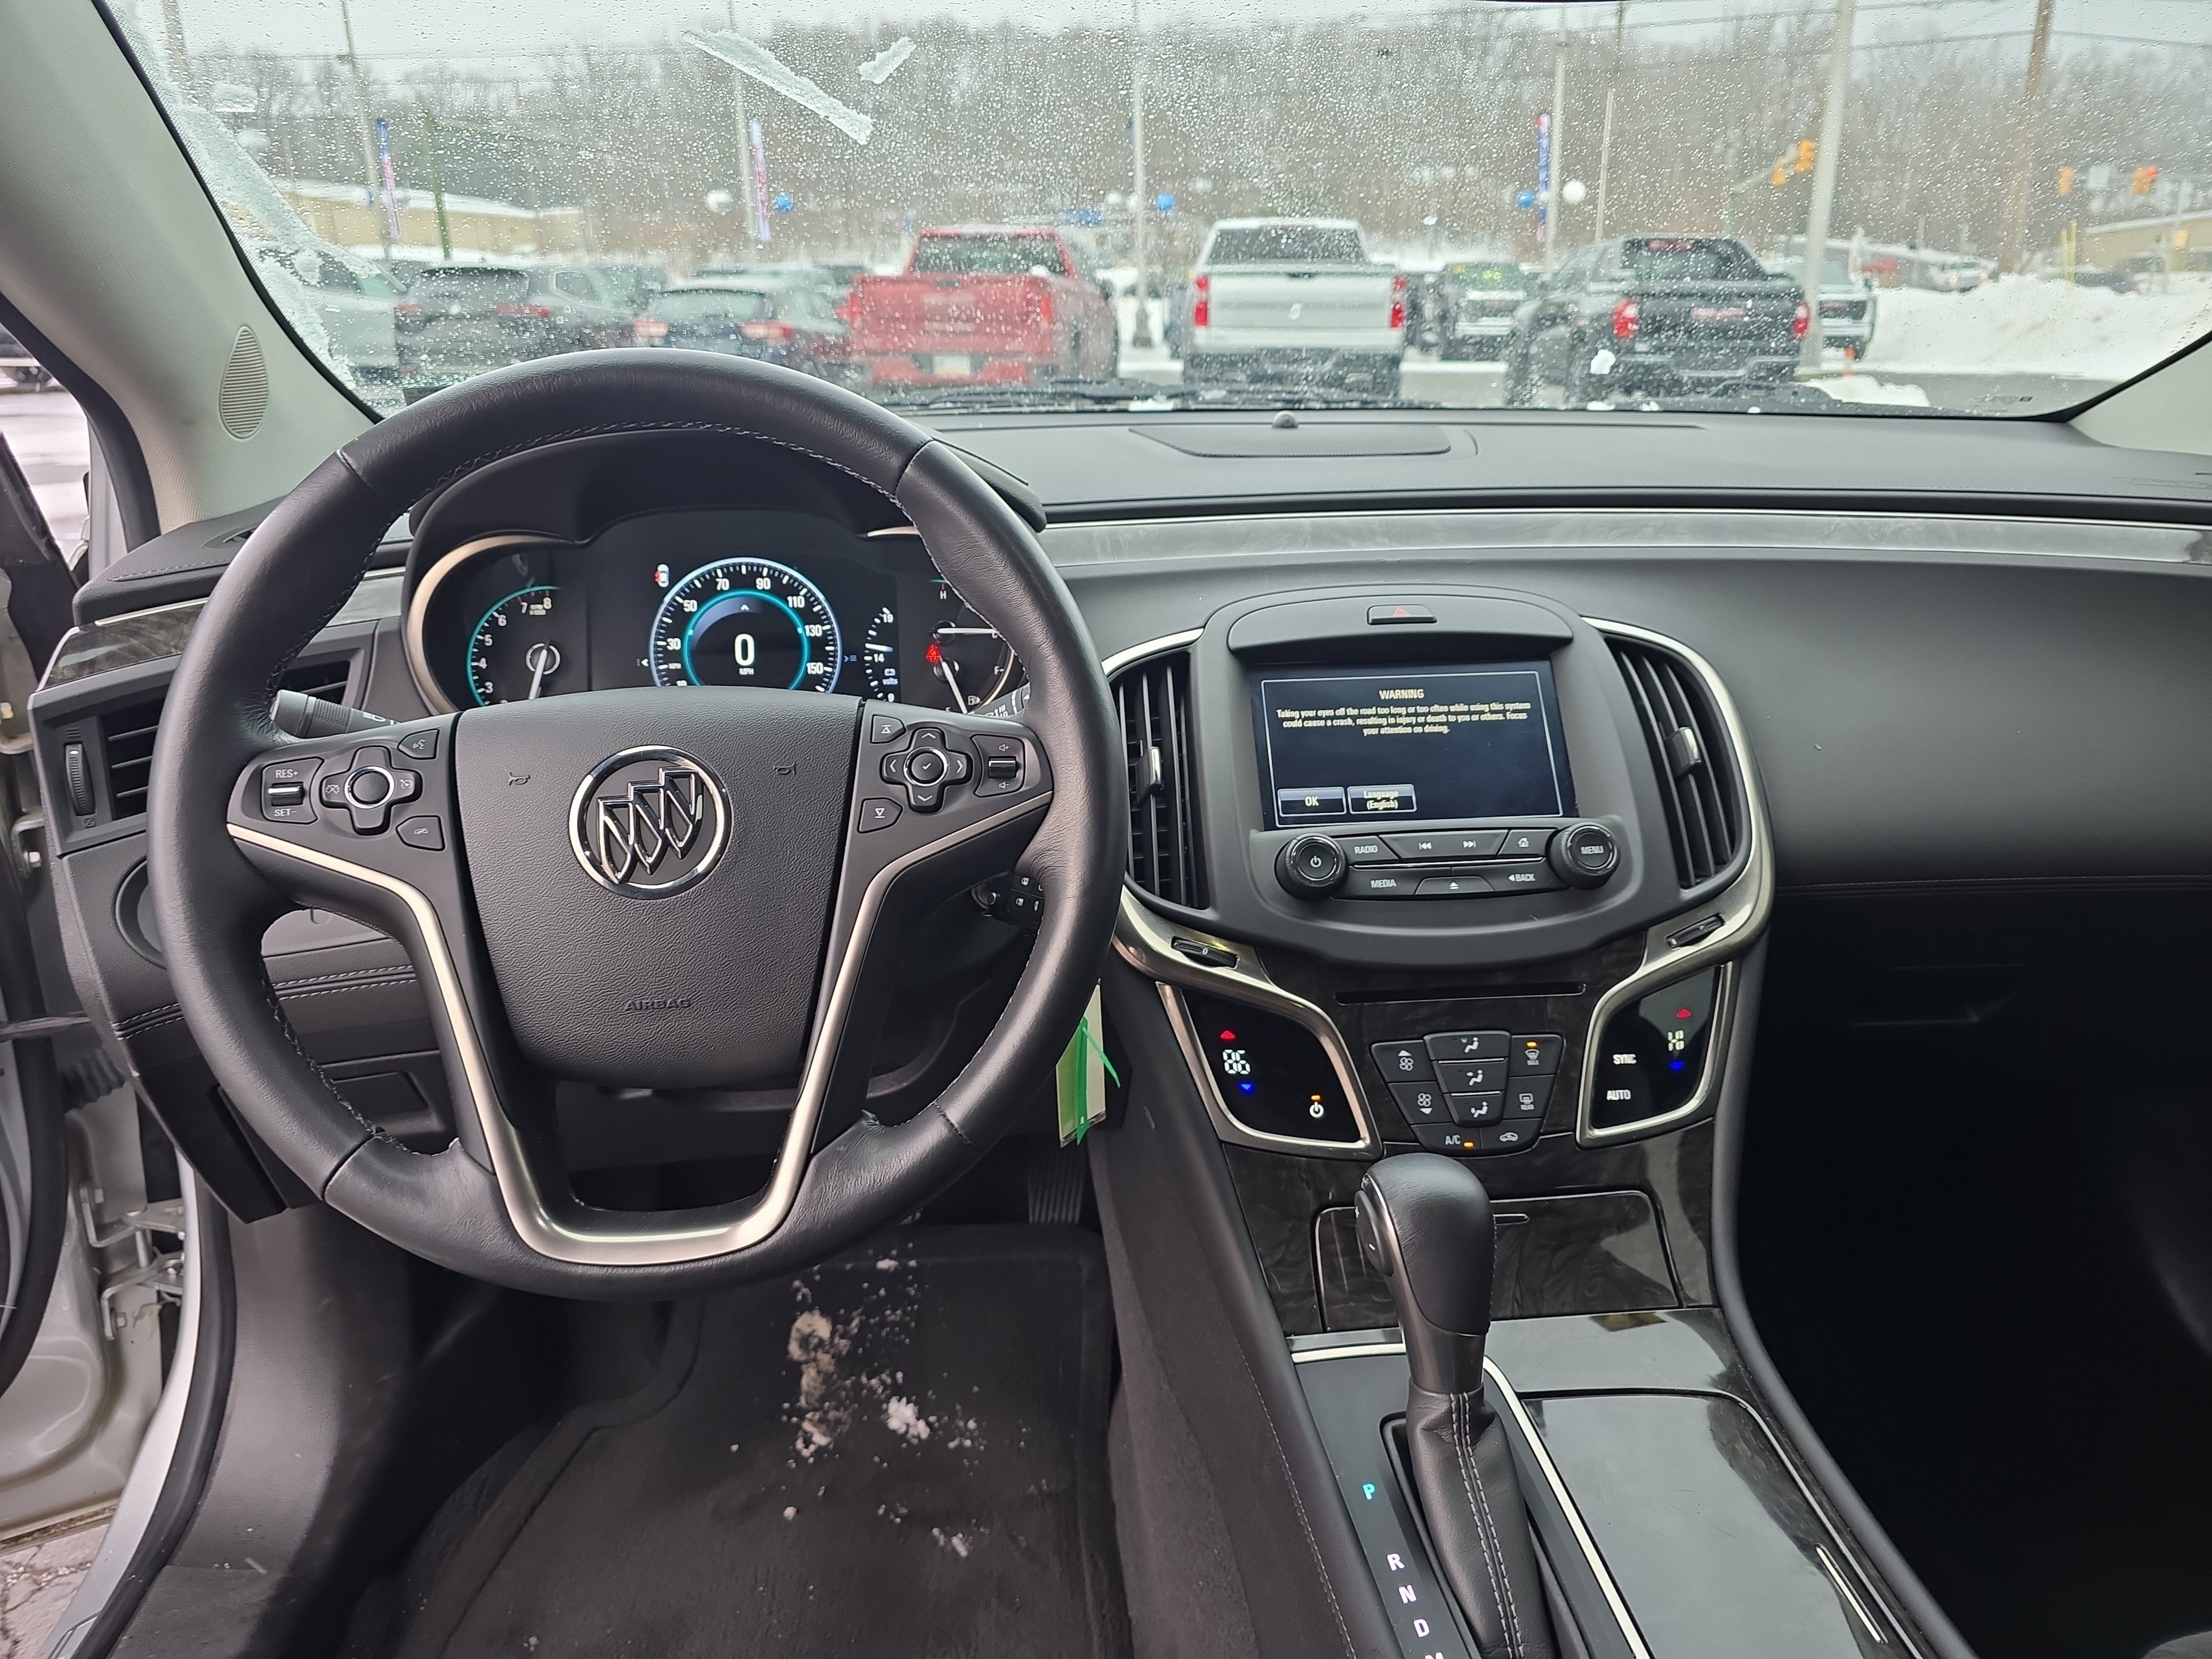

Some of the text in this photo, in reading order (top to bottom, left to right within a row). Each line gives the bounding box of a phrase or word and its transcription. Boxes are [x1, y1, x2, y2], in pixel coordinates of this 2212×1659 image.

[716, 578, 729, 590] 70
[756, 578, 770, 590] 90
[940, 591, 947, 600] H
[520, 602, 528, 614] 7
[543, 597, 552, 609] 8
[683, 600, 697, 612] 50
[787, 596, 805, 608] 110
[498, 614, 507, 626] 6
[882, 613, 893, 623] 19
[804, 625, 822, 636] 130
[484, 634, 493, 646] 5
[666, 638, 681, 650] 30
[734, 633, 755, 666] 0
[479, 658, 487, 669] 4
[873, 653, 885, 663] 14
[806, 663, 824, 674] 150
[994, 666, 1000, 675] F
[485, 681, 493, 693] 3
[888, 693, 894, 702] 9
[1379, 689, 1425, 699] WARNING
[1276, 709, 1299, 718] Taking
[1301, 710, 1316, 718] your
[1317, 709, 1334, 718] eyes
[1335, 707, 1345, 716] off
[1347, 707, 1359, 715] the
[1360, 706, 1376, 715] road
[1391, 706, 1406, 715] long
[1430, 704, 1449, 712] often
[1449, 703, 1469, 711] while
[1470, 703, 1489, 712] using
[1504, 703, 1531, 711] system
[1283, 719, 1302, 728] could
[1333, 717, 1355, 726] crash,
[1356, 716, 1387, 725] resulting
[1388, 716, 1395, 724] in
[1396, 716, 1416, 724] injury
[1426, 714, 1447, 723] death
[1457, 715, 1470, 723] you
[1480, 712, 1505, 721] others.
[1506, 711, 1528, 720] Focus
[1362, 727, 1379, 736] your
[1380, 725, 1412, 734] attention
[1424, 724, 1450, 734] driving.
[275, 769, 299, 779] RES+
[1304, 796, 1319, 806] OK
[1364, 790, 1399, 800] Language
[1366, 800, 1398, 810] (English)
[1354, 844, 1378, 854] RADIO
[1580, 845, 1604, 855] MENU
[1371, 878, 1397, 889] MEDIA
[1515, 873, 1536, 882] BACK
[624, 998, 690, 1011] AIRBAG
[1223, 1049, 1251, 1075] 86
[1612, 1054, 1637, 1065] SYNC
[1606, 1089, 1631, 1101] AUTO
[1445, 1134, 1461, 1146] A/C
[1362, 1483, 1375, 1500] P
[1387, 1553, 1405, 1571] R
[1398, 1585, 1417, 1604] N
[1413, 1619, 1430, 1638] D
